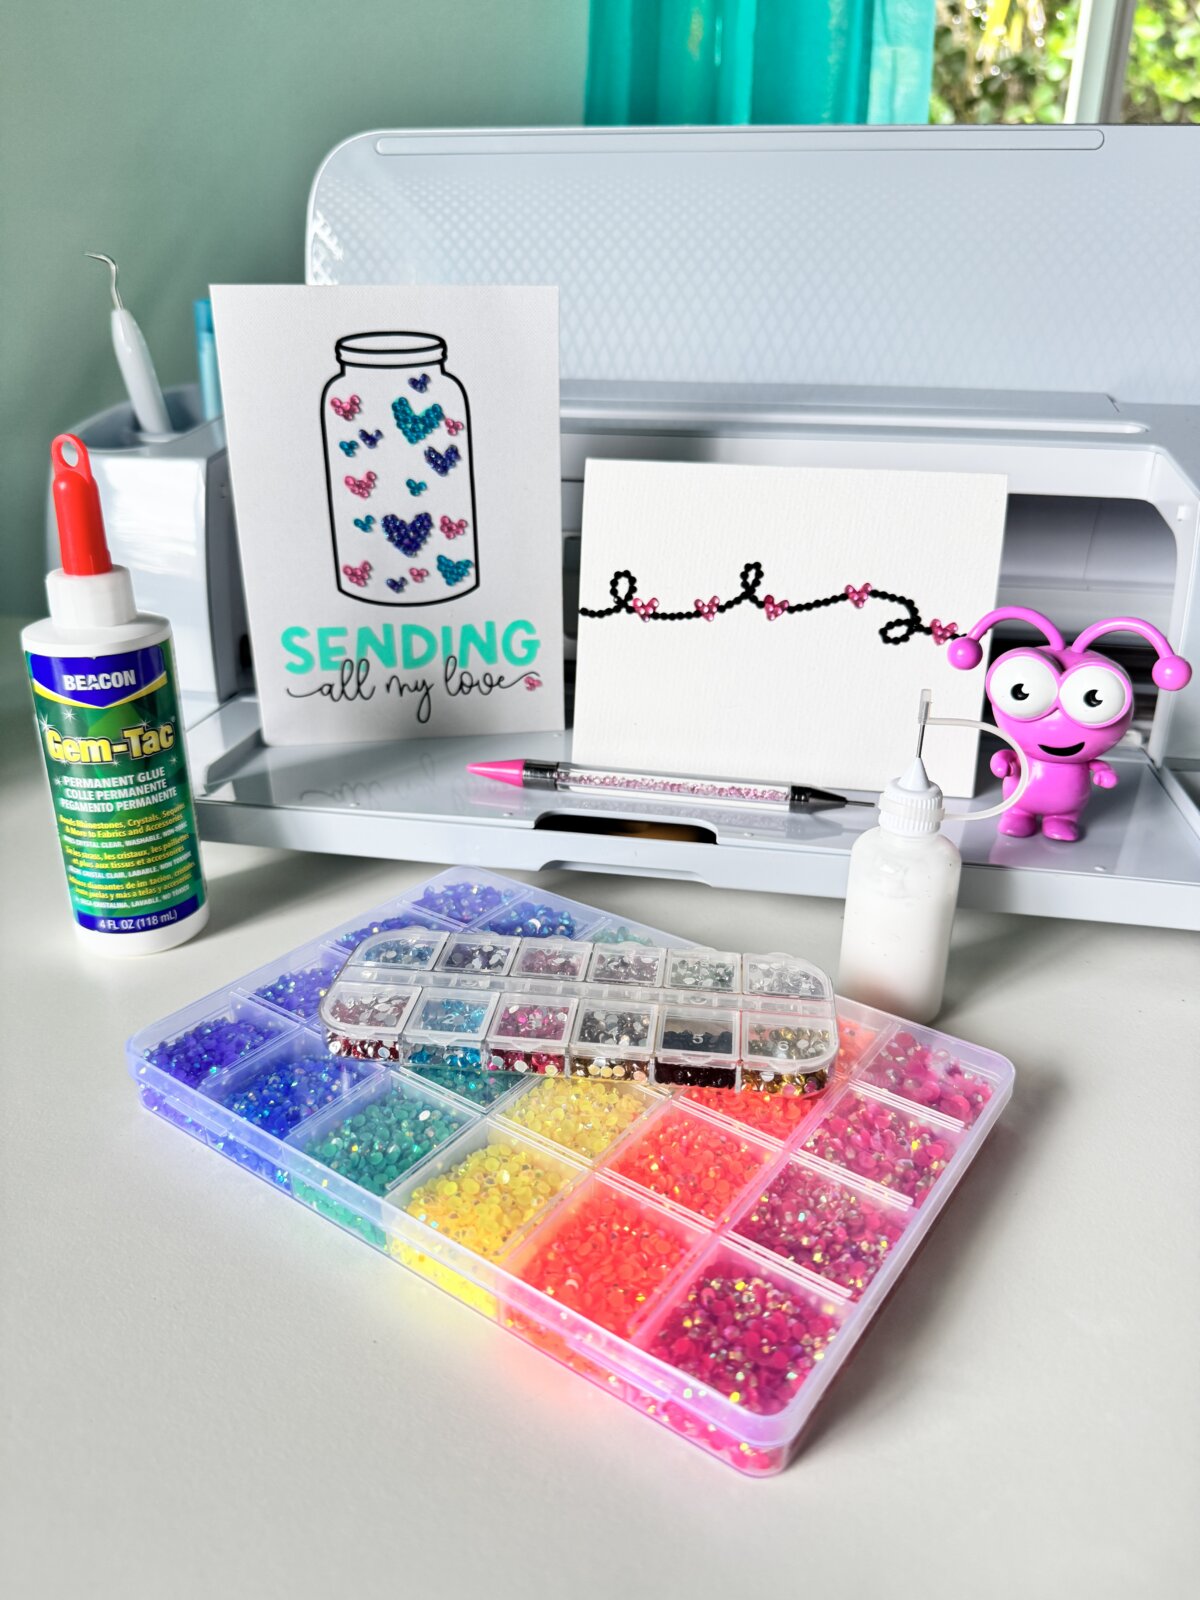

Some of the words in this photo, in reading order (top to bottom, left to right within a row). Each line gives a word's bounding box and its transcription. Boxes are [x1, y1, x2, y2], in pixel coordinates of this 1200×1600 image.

[281, 619, 541, 674] SENDING
[62, 669, 137, 692] BEACON
[287, 658, 376, 702] all
[386, 675, 434, 724] my
[445, 655, 541, 697] love
[45, 722, 175, 764] Gem-Tac
[63, 774, 135, 788] PERMANENT
[138, 766, 166, 782] GLUE
[60, 798, 114, 812] PEGAMENTO
[116, 787, 178, 811] PERMANENTE
[66, 788, 95, 801] COLLE
[96, 779, 167, 800] PERMANENTE
[128, 826, 144, 836] and
[100, 920, 106, 929] 4
[107, 921, 120, 930] FL
[121, 919, 135, 930] OZ
[136, 915, 158, 930] (118
[160, 909, 178, 923] mL)
[692, 1033, 704, 1044] 5
